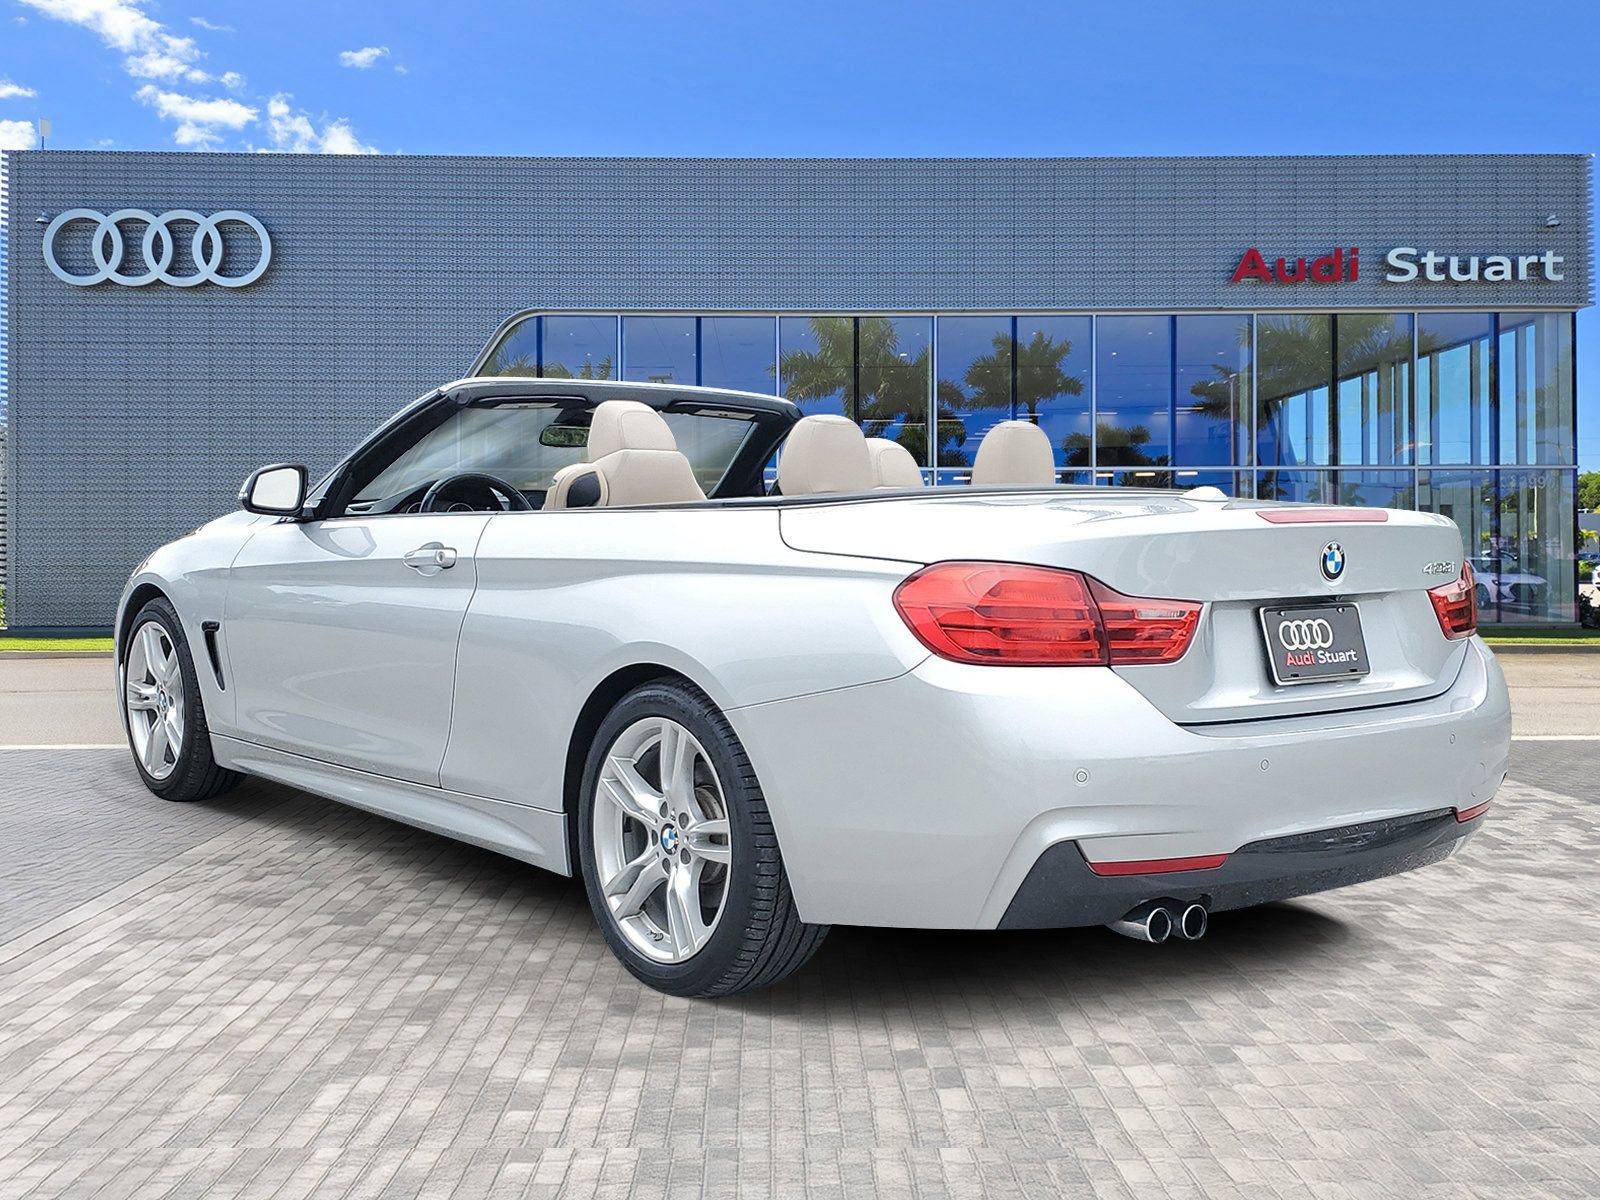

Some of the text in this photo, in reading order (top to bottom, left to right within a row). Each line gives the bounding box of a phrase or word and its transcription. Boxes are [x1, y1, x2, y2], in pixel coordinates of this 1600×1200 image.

[1232, 247, 1565, 283] Audi Stuart
[1286, 649, 1358, 666] Audi Stuart
